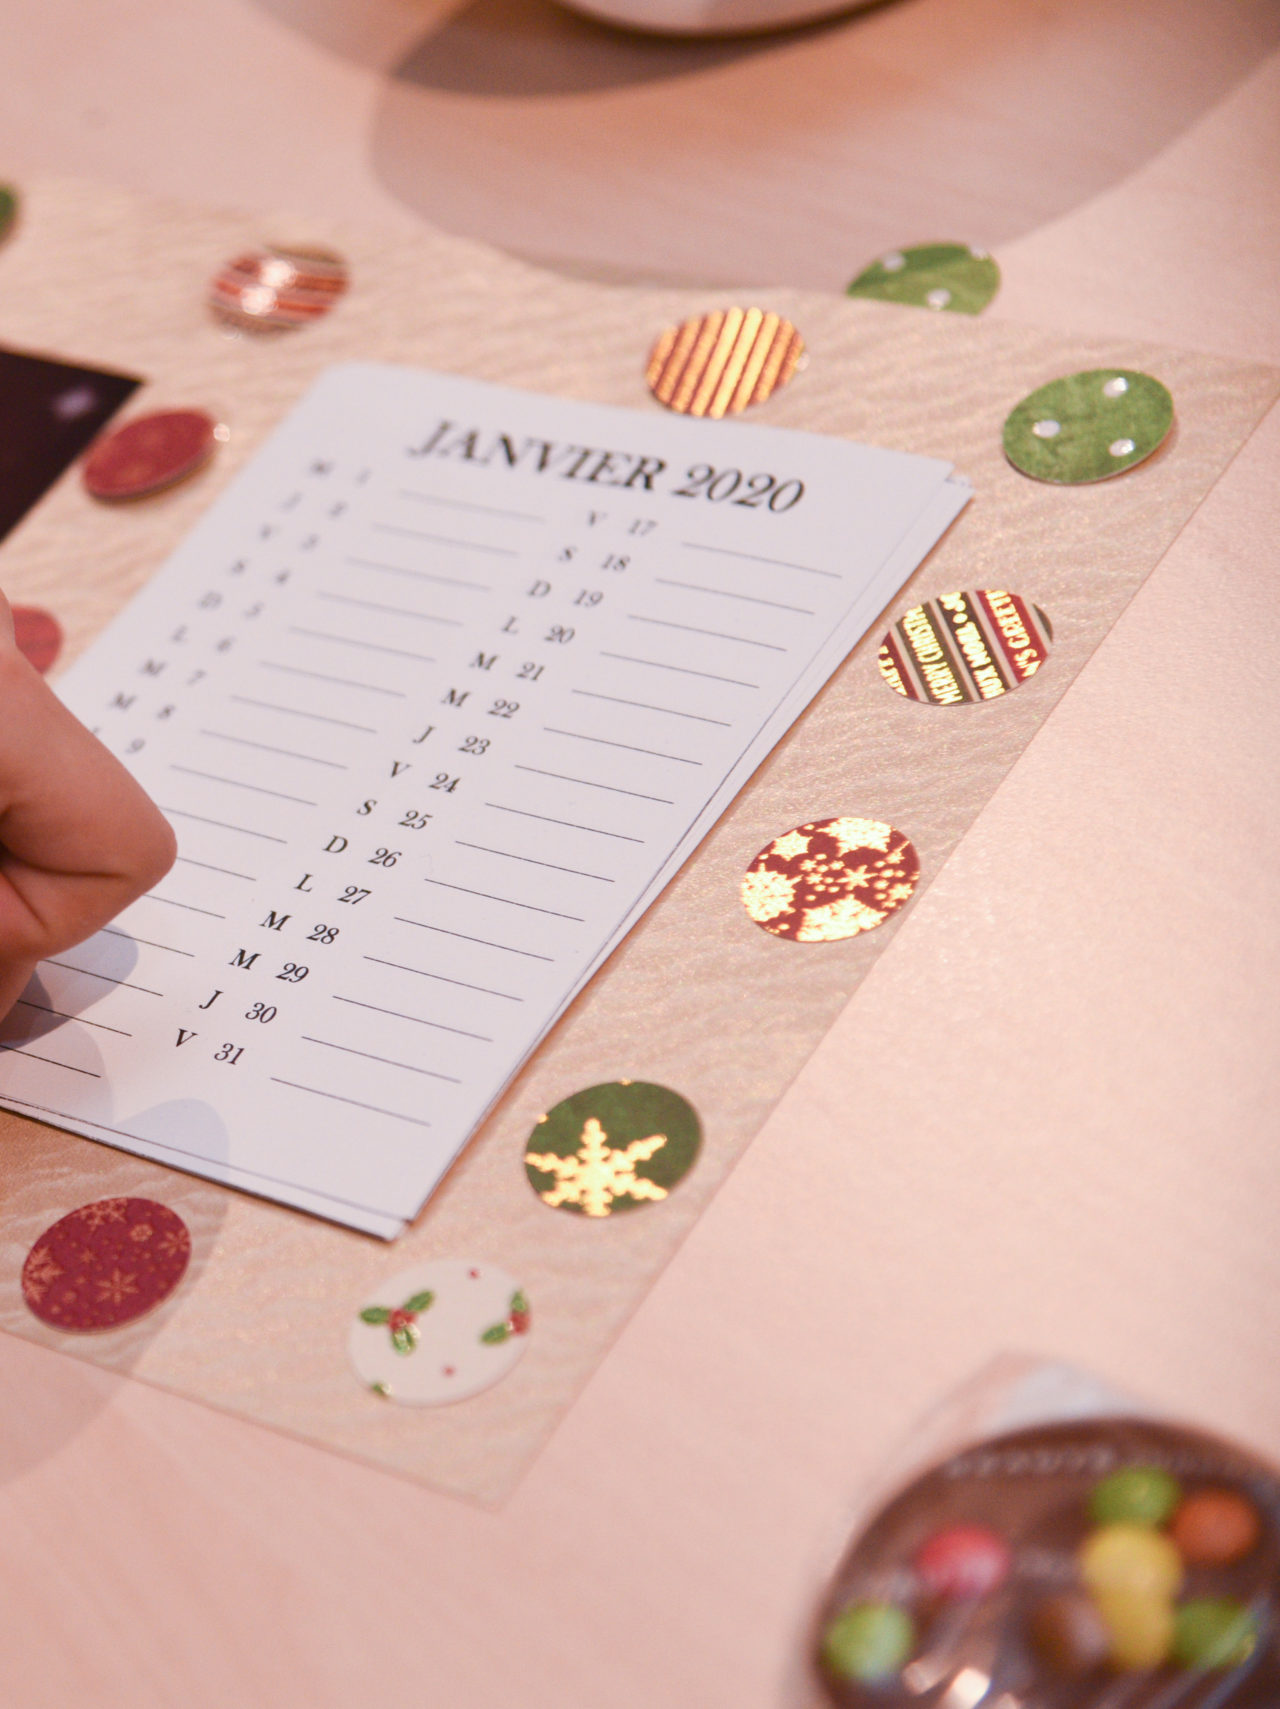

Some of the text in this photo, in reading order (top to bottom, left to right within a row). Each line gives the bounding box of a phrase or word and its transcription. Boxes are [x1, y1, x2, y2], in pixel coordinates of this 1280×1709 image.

[407, 420, 805, 512] JANVIER 2020
[587, 509, 658, 536] V 17
[557, 547, 630, 571] S 18
[526, 580, 604, 607] D 19
[501, 616, 575, 644] L 20
[984, 589, 1031, 648] GREETI
[187, 669, 207, 685] 7
[470, 652, 545, 681] M 21
[922, 662, 963, 704] MERRY
[157, 705, 175, 719] 8
[441, 688, 520, 719] M 22
[412, 725, 491, 755] J 23
[391, 761, 460, 793] V 24
[357, 800, 433, 829] S 25
[323, 835, 402, 867] D 26
[294, 874, 372, 905] L 27
[260, 911, 339, 944] M 28
[228, 949, 309, 983] M 29
[199, 990, 277, 1023] J 30
[176, 1028, 244, 1065] V 31
